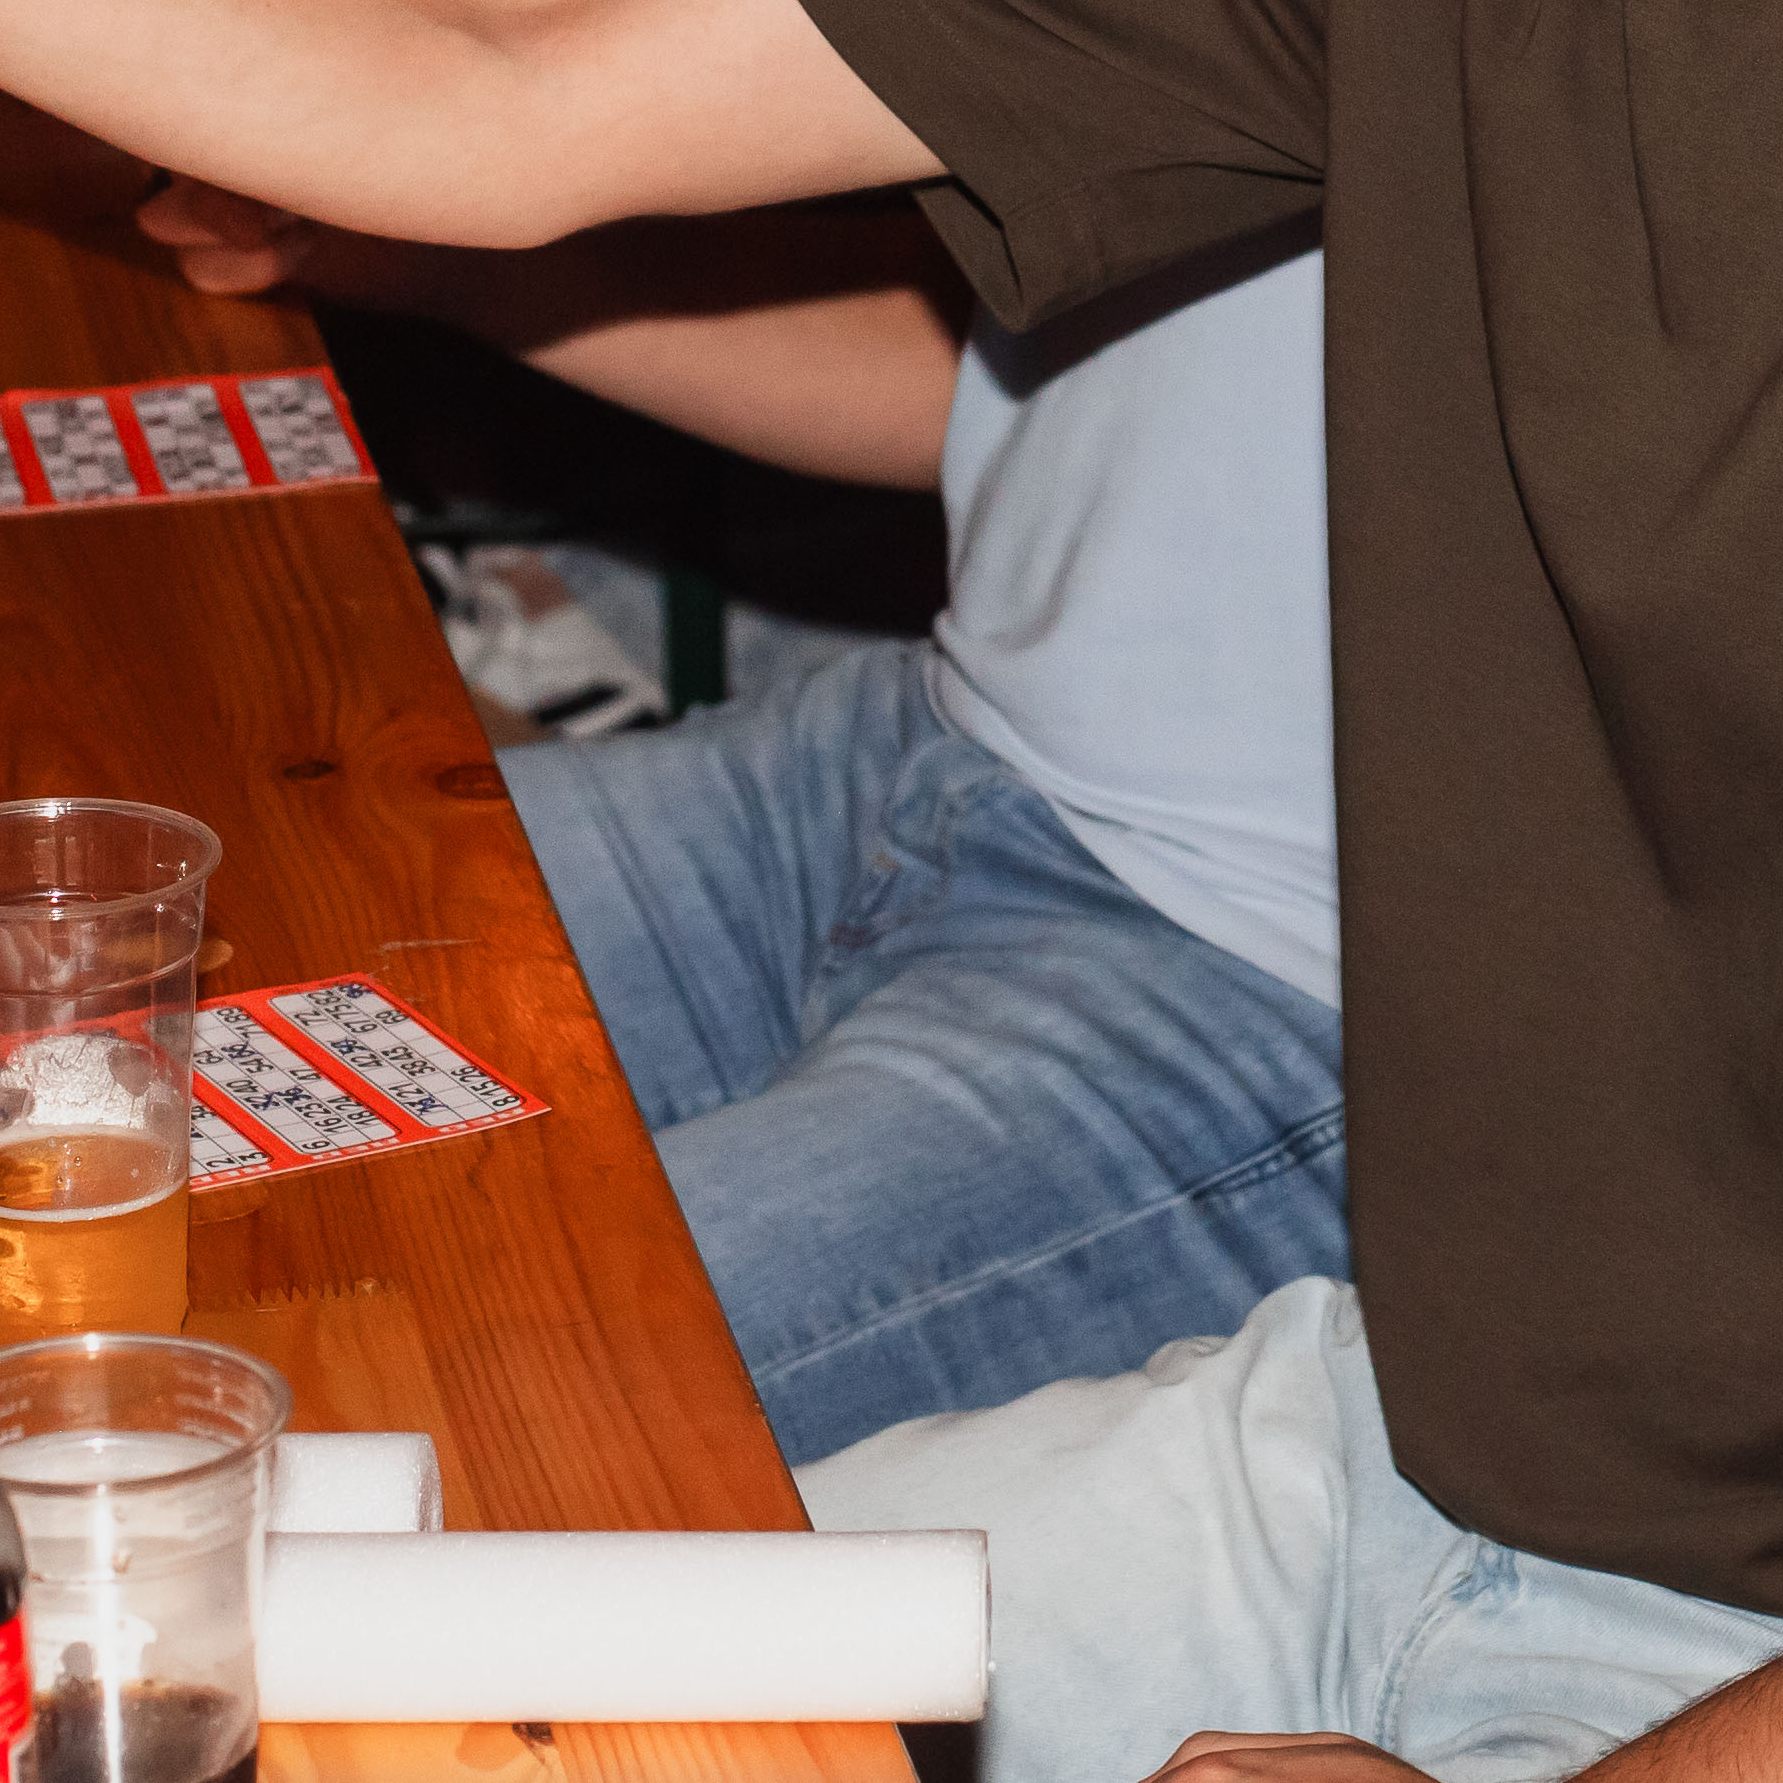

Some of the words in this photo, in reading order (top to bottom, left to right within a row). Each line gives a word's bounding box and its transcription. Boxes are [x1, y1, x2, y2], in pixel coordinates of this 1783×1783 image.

[307, 992, 342, 1005] 82
[217, 1008, 250, 1023] 89
[294, 1012, 331, 1026] 72
[325, 1004, 360, 1020] 75
[375, 1010, 409, 1024] 69
[235, 1024, 267, 1038] 71
[343, 1020, 378, 1034] 67
[192, 1050, 224, 1065] 64
[382, 1046, 416, 1061] 43
[239, 1058, 273, 1074] 54
[351, 1054, 385, 1068] 42
[290, 1068, 321, 1081] 47
[400, 1061, 436, 1076] 38
[451, 1066, 486, 1082] 26
[226, 1080, 258, 1093] 40
[389, 1084, 424, 1098] 21
[473, 1081, 504, 1096] 15
[327, 1096, 363, 1111] 24
[492, 1096, 520, 1106] 8
[295, 1103, 331, 1118] 23
[347, 1111, 382, 1125] 18
[314, 1118, 348, 1133] 16
[302, 1141, 330, 1150] 6
[205, 1158, 235, 1167] 2
[237, 1152, 267, 1160] 3
